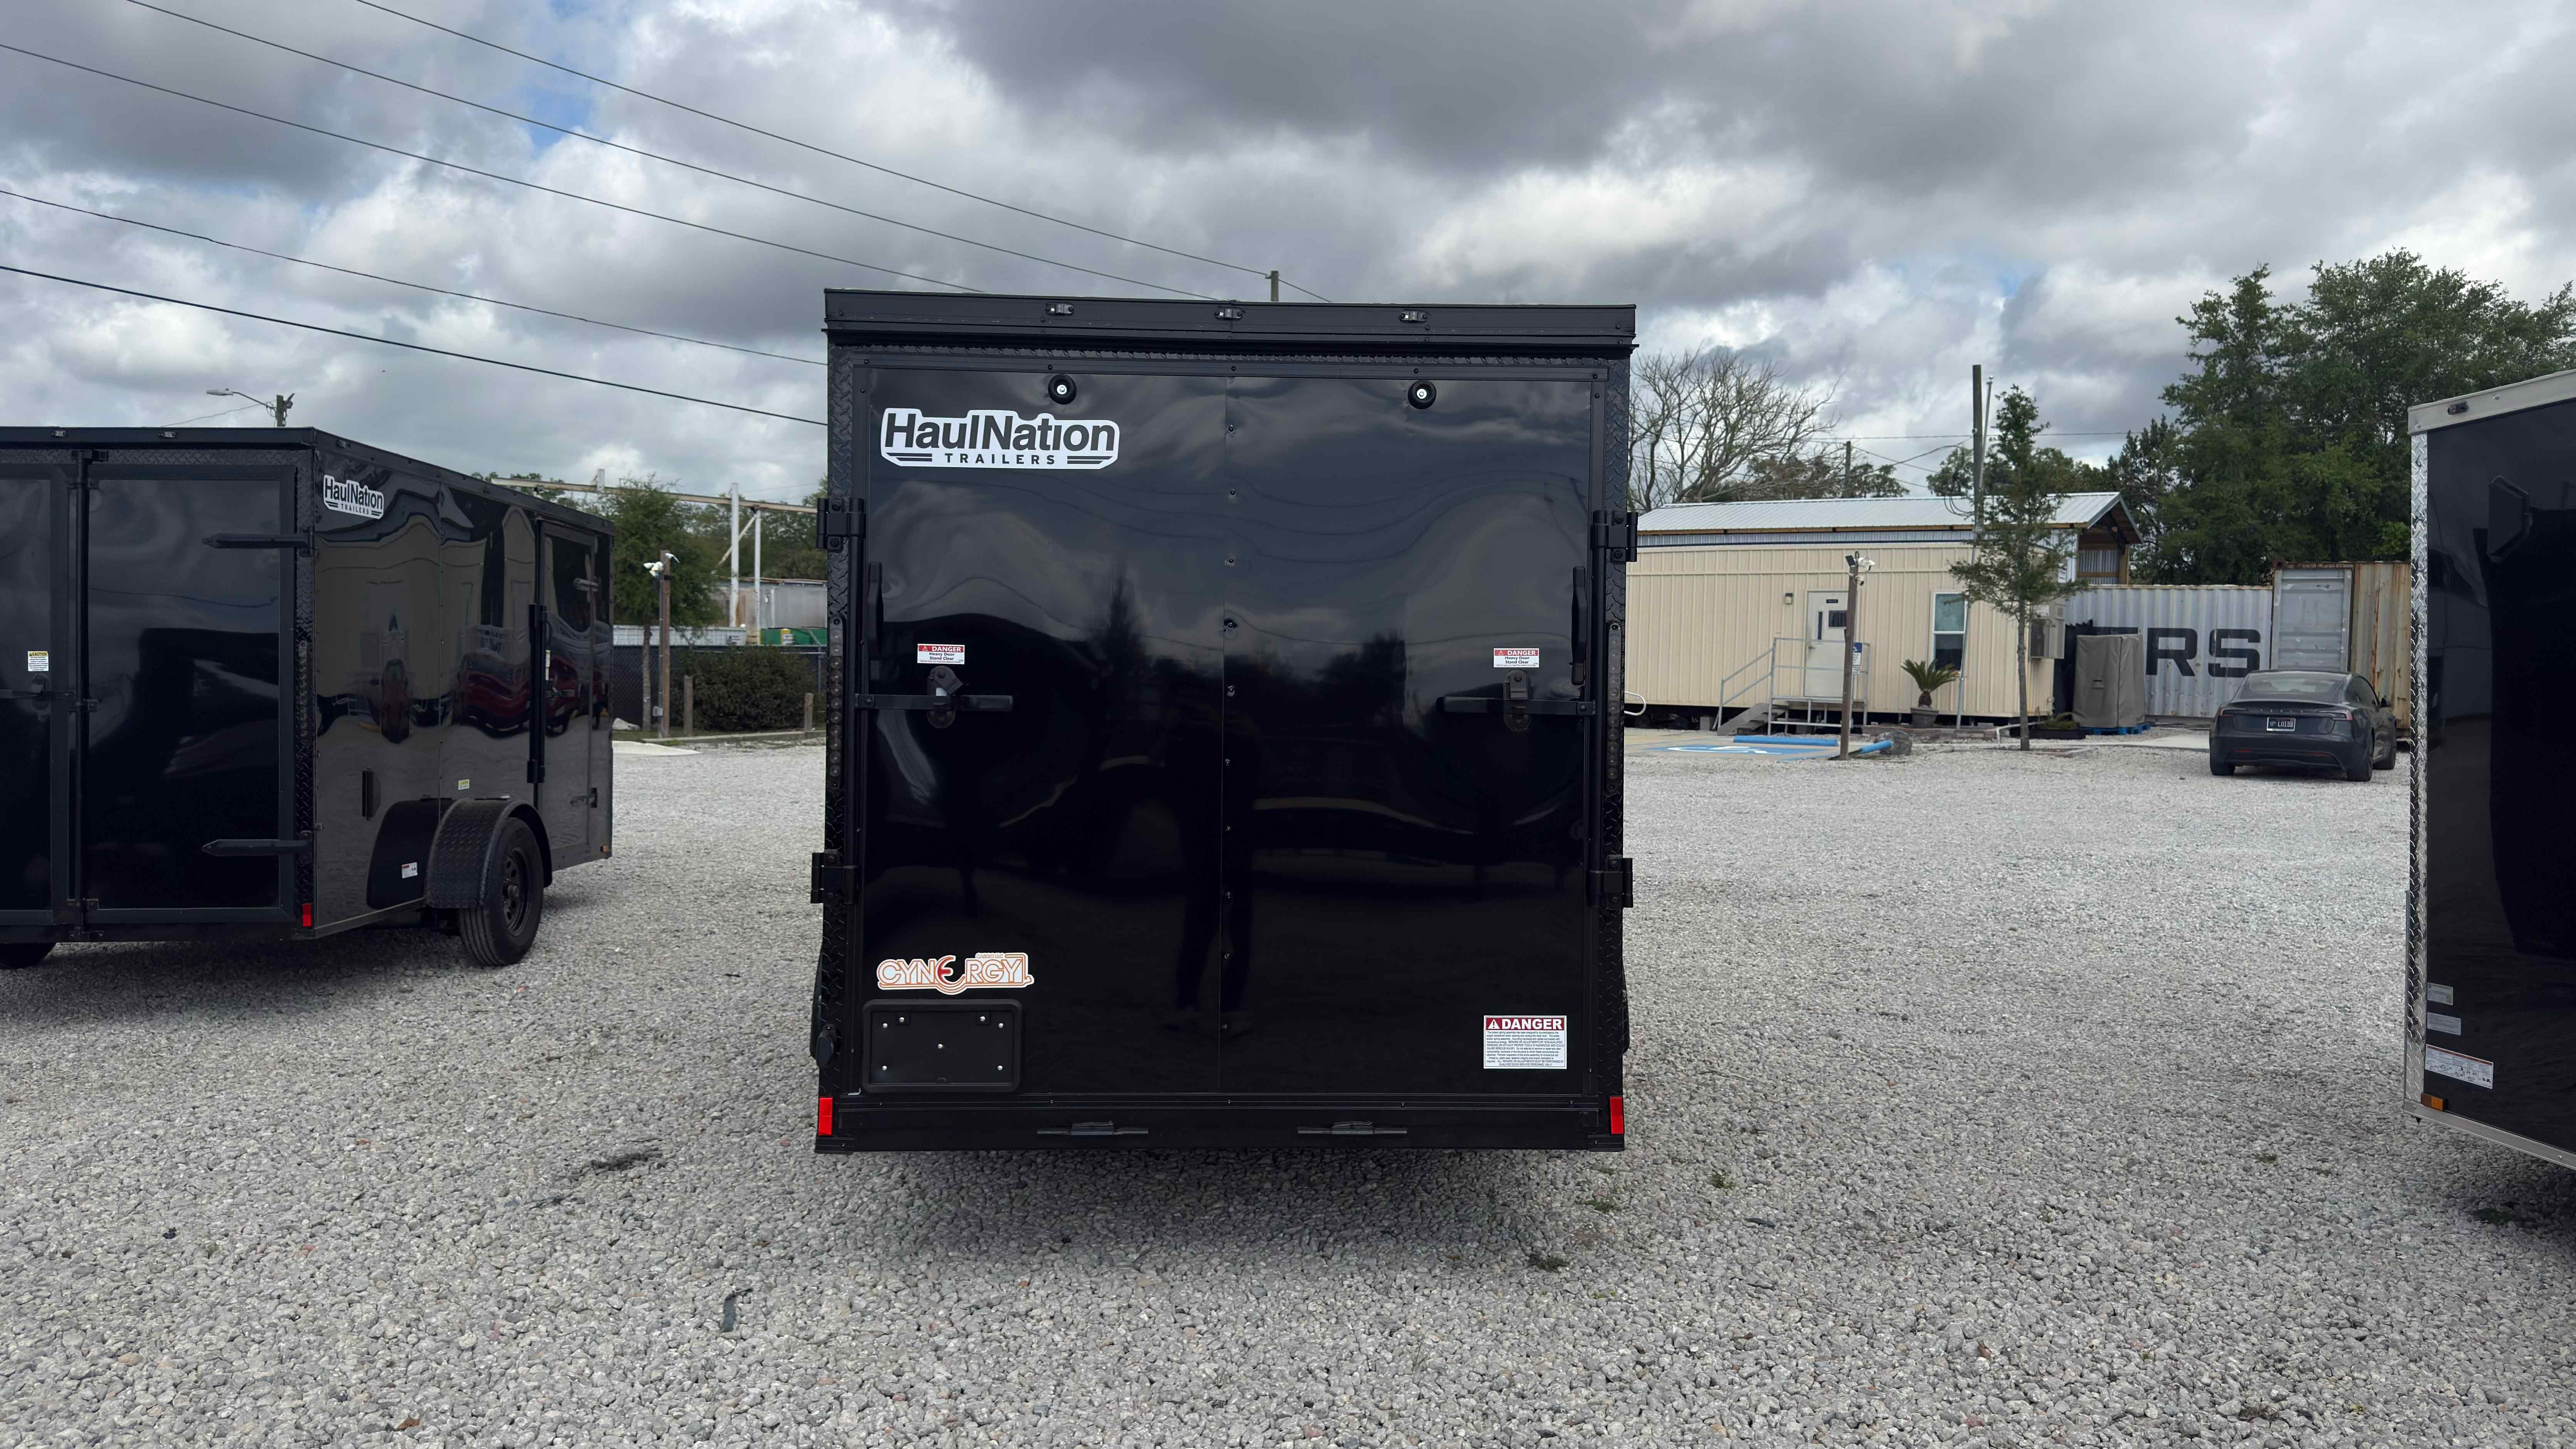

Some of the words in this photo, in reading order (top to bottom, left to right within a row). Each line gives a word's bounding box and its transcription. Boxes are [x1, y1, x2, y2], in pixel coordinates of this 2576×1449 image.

[885, 413, 1114, 451] HaulNation
[945, 453, 1055, 465] TRAILERS
[325, 478, 383, 510] HaulNation
[341, 503, 369, 515] TRAILERS
[1502, 1018, 1563, 1030] DANGER
